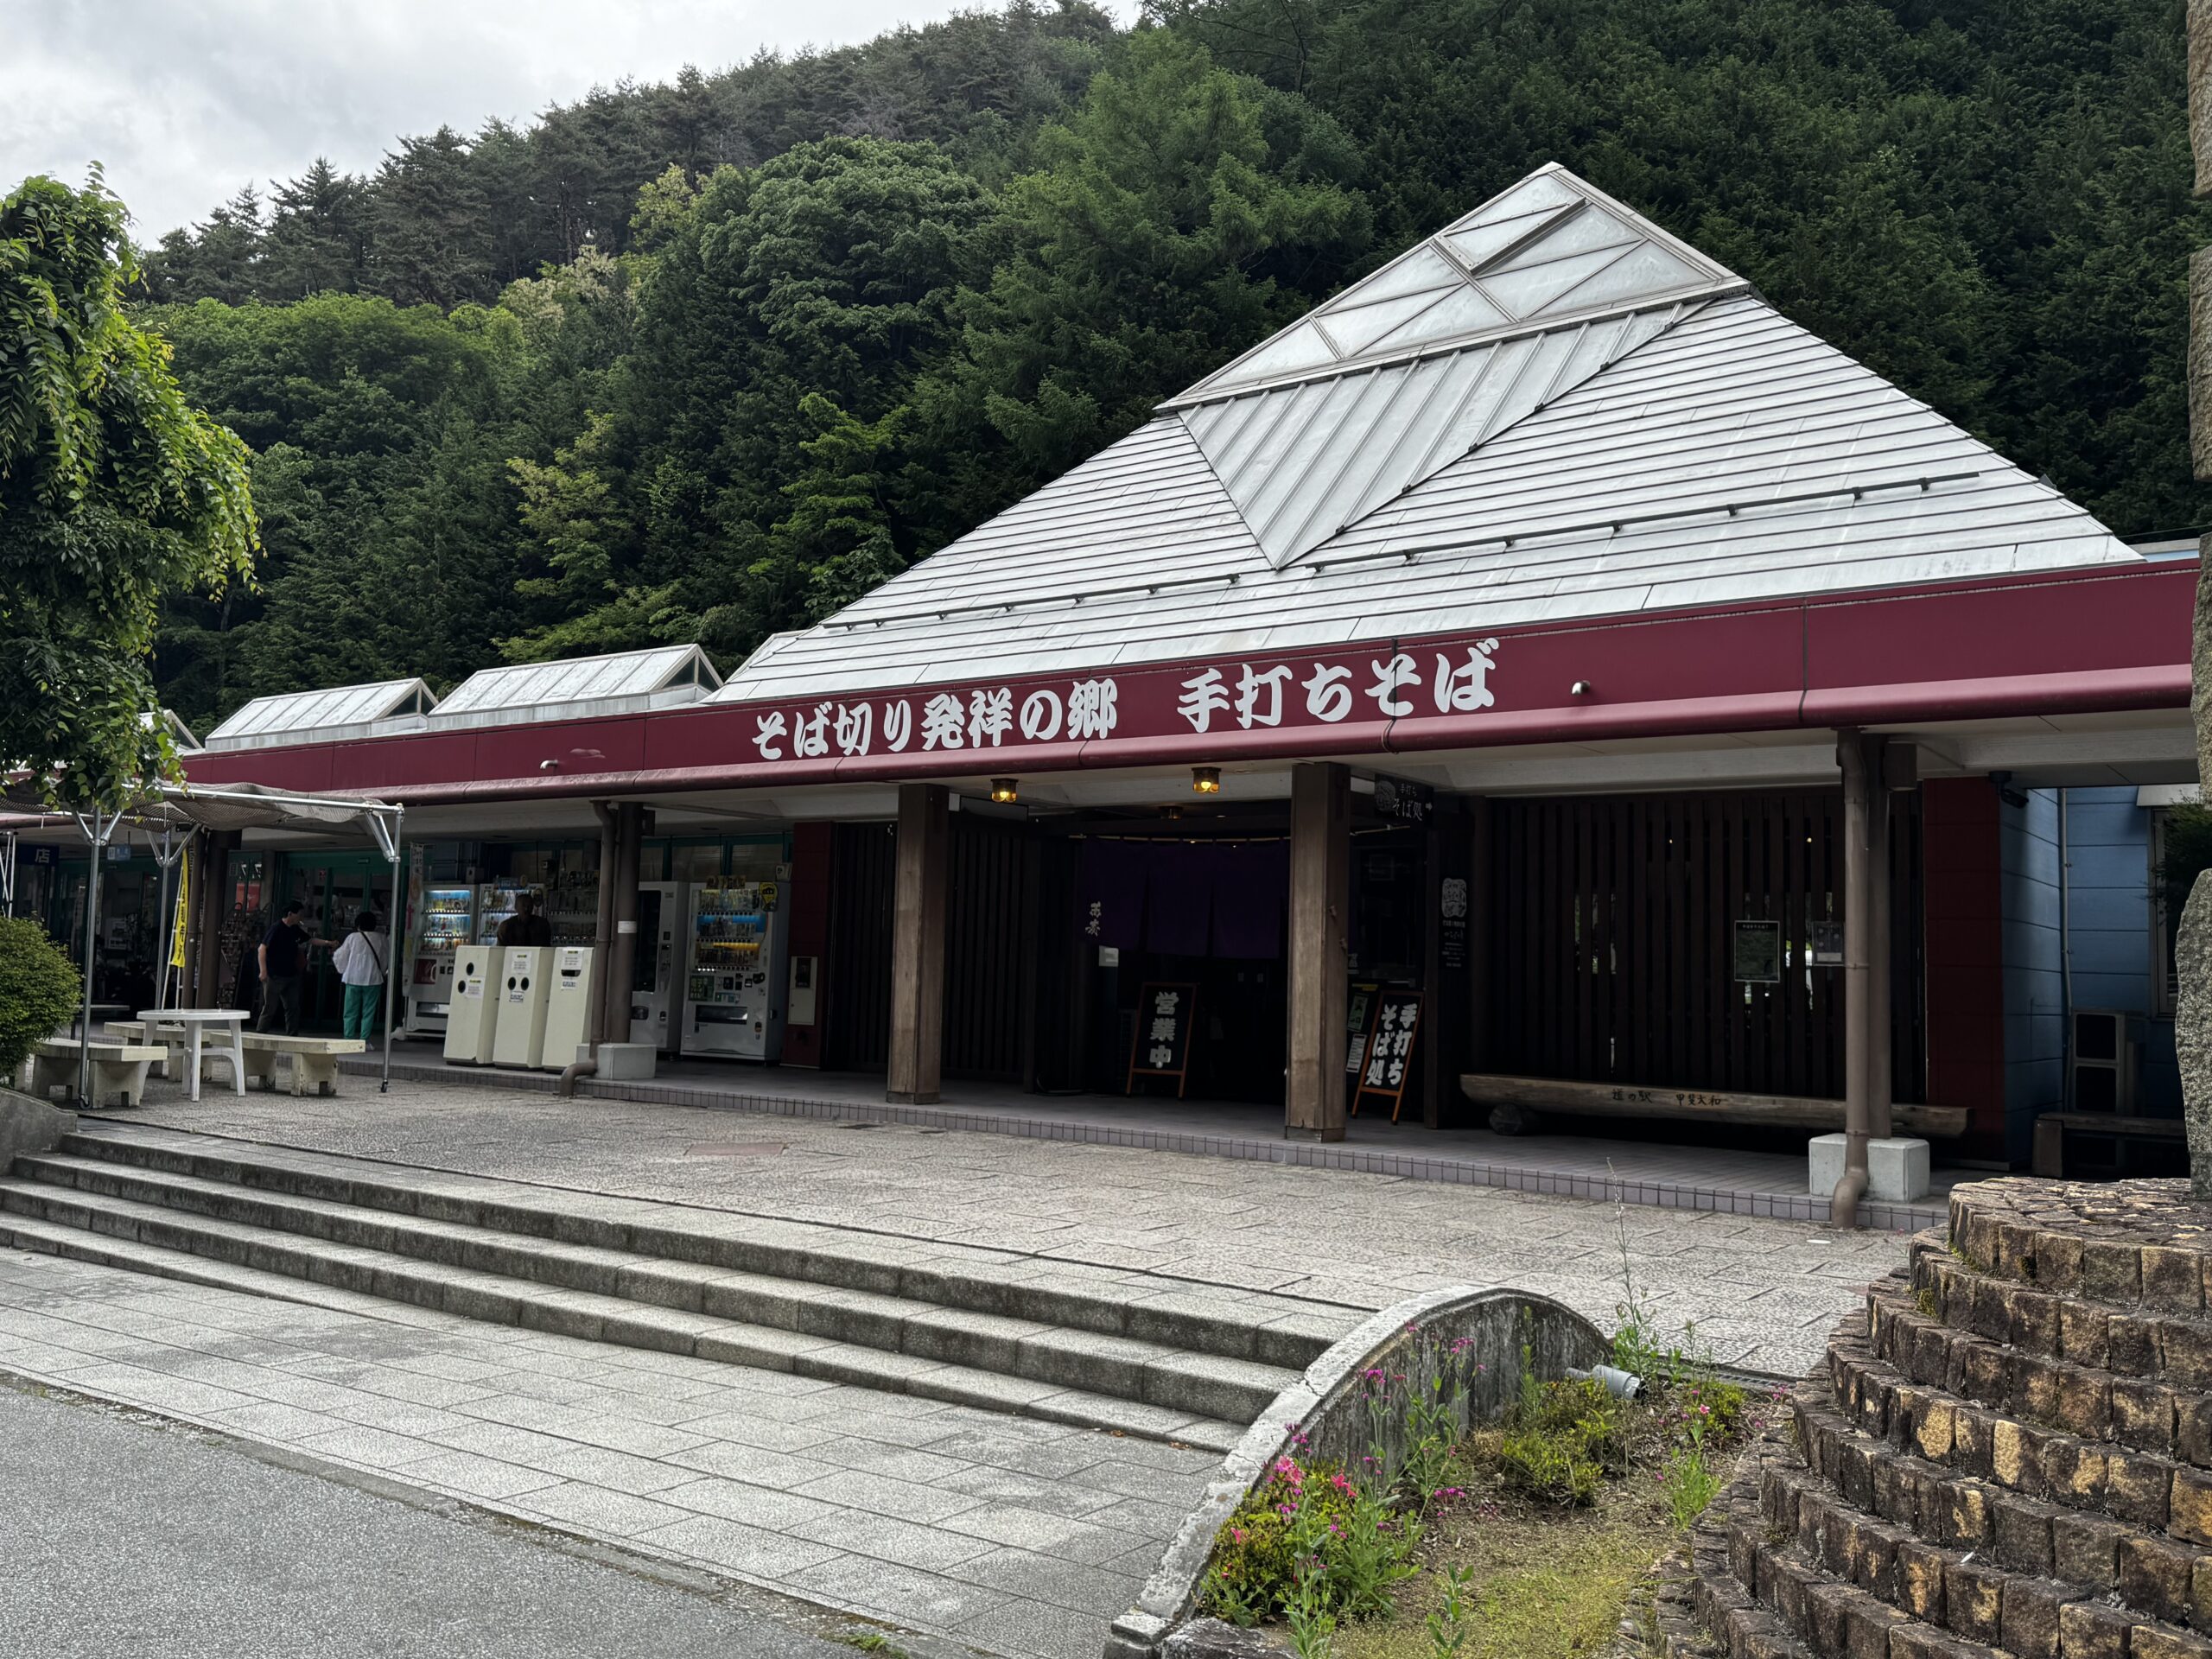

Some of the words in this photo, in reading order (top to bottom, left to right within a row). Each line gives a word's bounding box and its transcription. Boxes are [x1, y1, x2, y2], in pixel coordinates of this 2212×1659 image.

[752, 677, 1118, 760] そば切り発祥の郷
[1176, 637, 1501, 734] 手打ちそば
[1149, 991, 1179, 1068] 営業中
[1365, 1003, 1398, 1086] そば処
[1387, 1003, 1418, 1085] 手打ち
